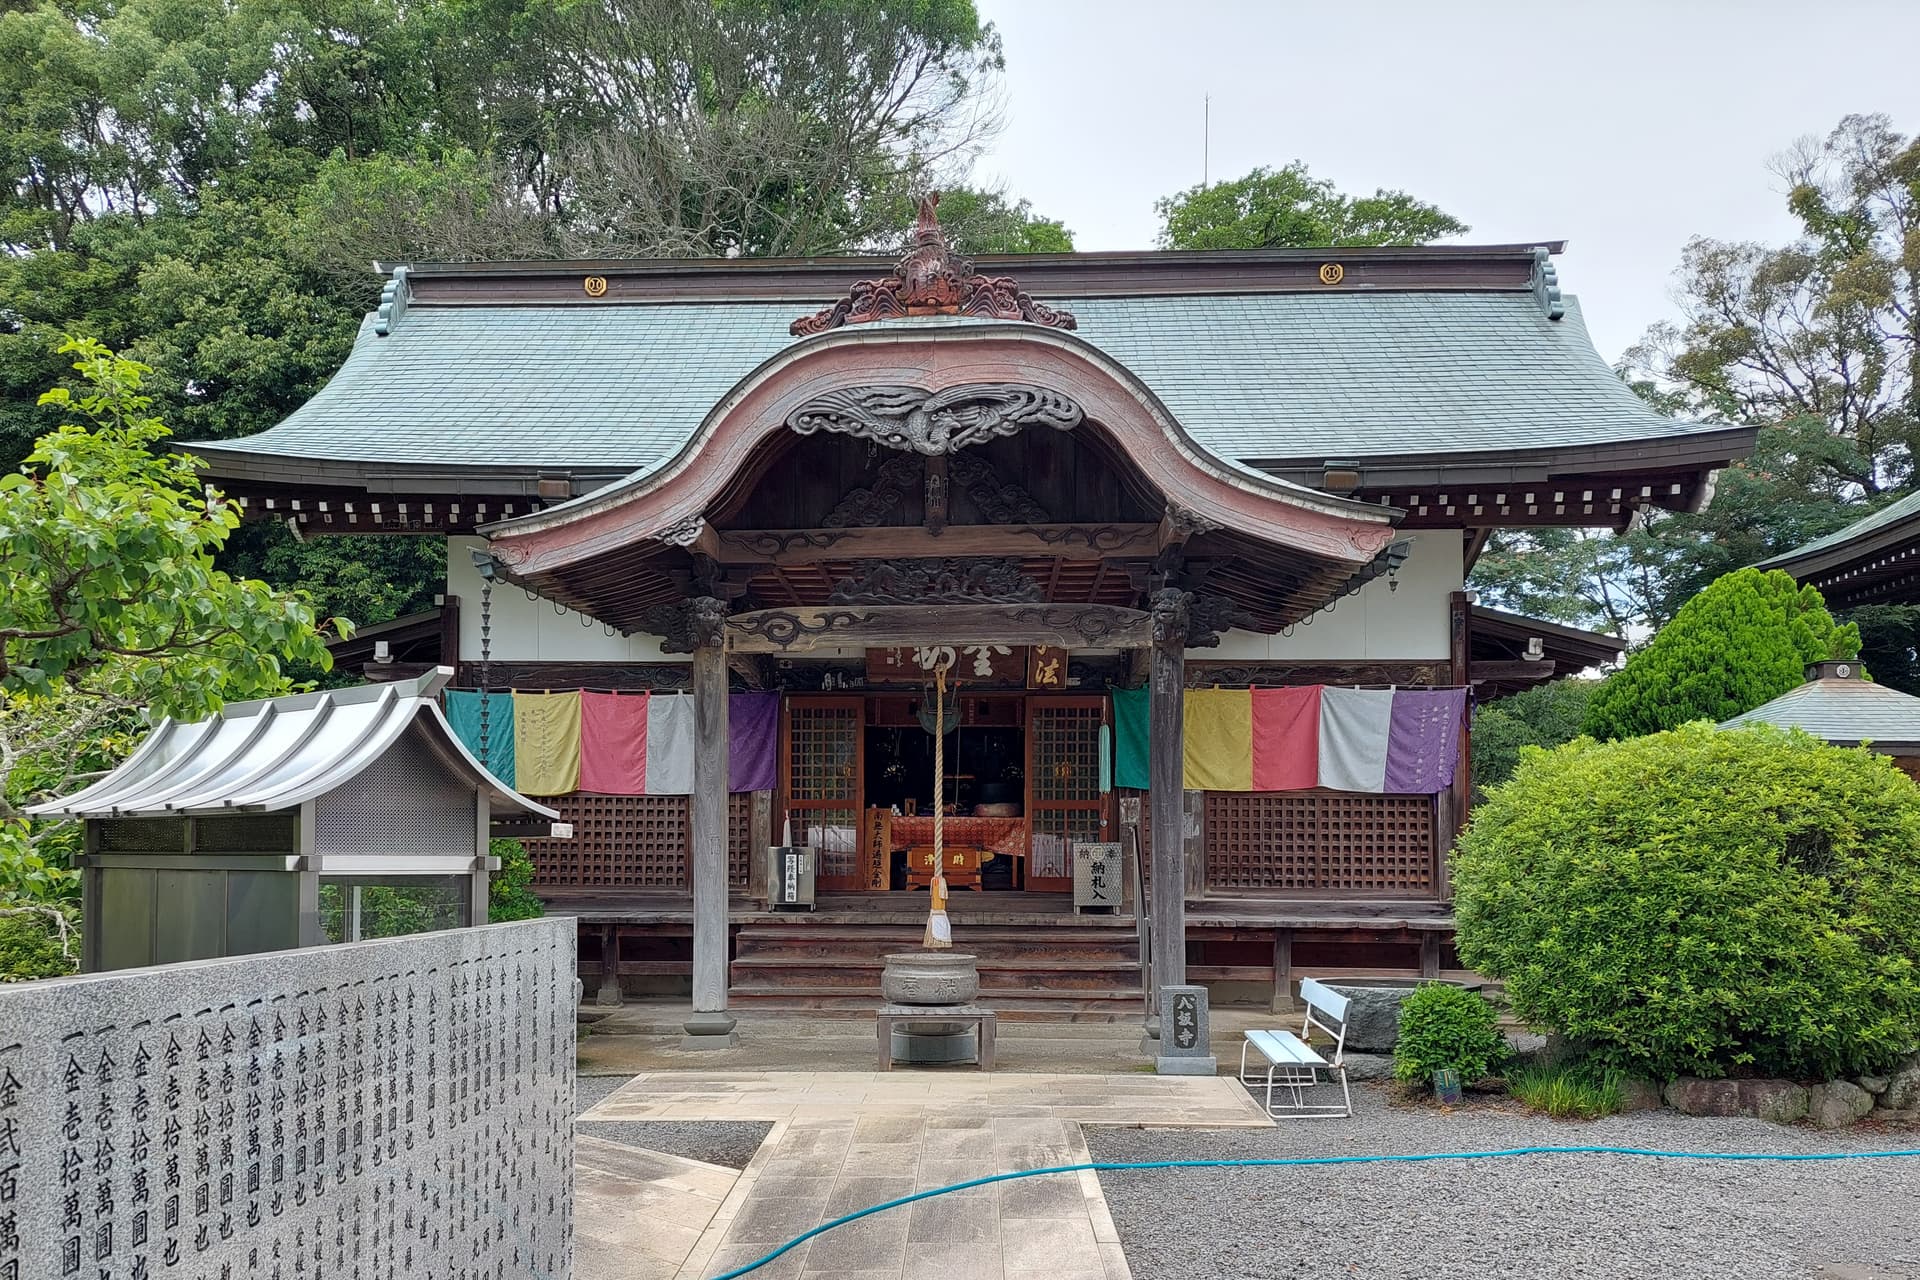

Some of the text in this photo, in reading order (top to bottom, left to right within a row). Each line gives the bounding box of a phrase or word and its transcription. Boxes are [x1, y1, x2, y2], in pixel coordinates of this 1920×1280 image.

[1090, 861, 1107, 900] 納札入
[1177, 995, 1195, 1048] 八坂寺
